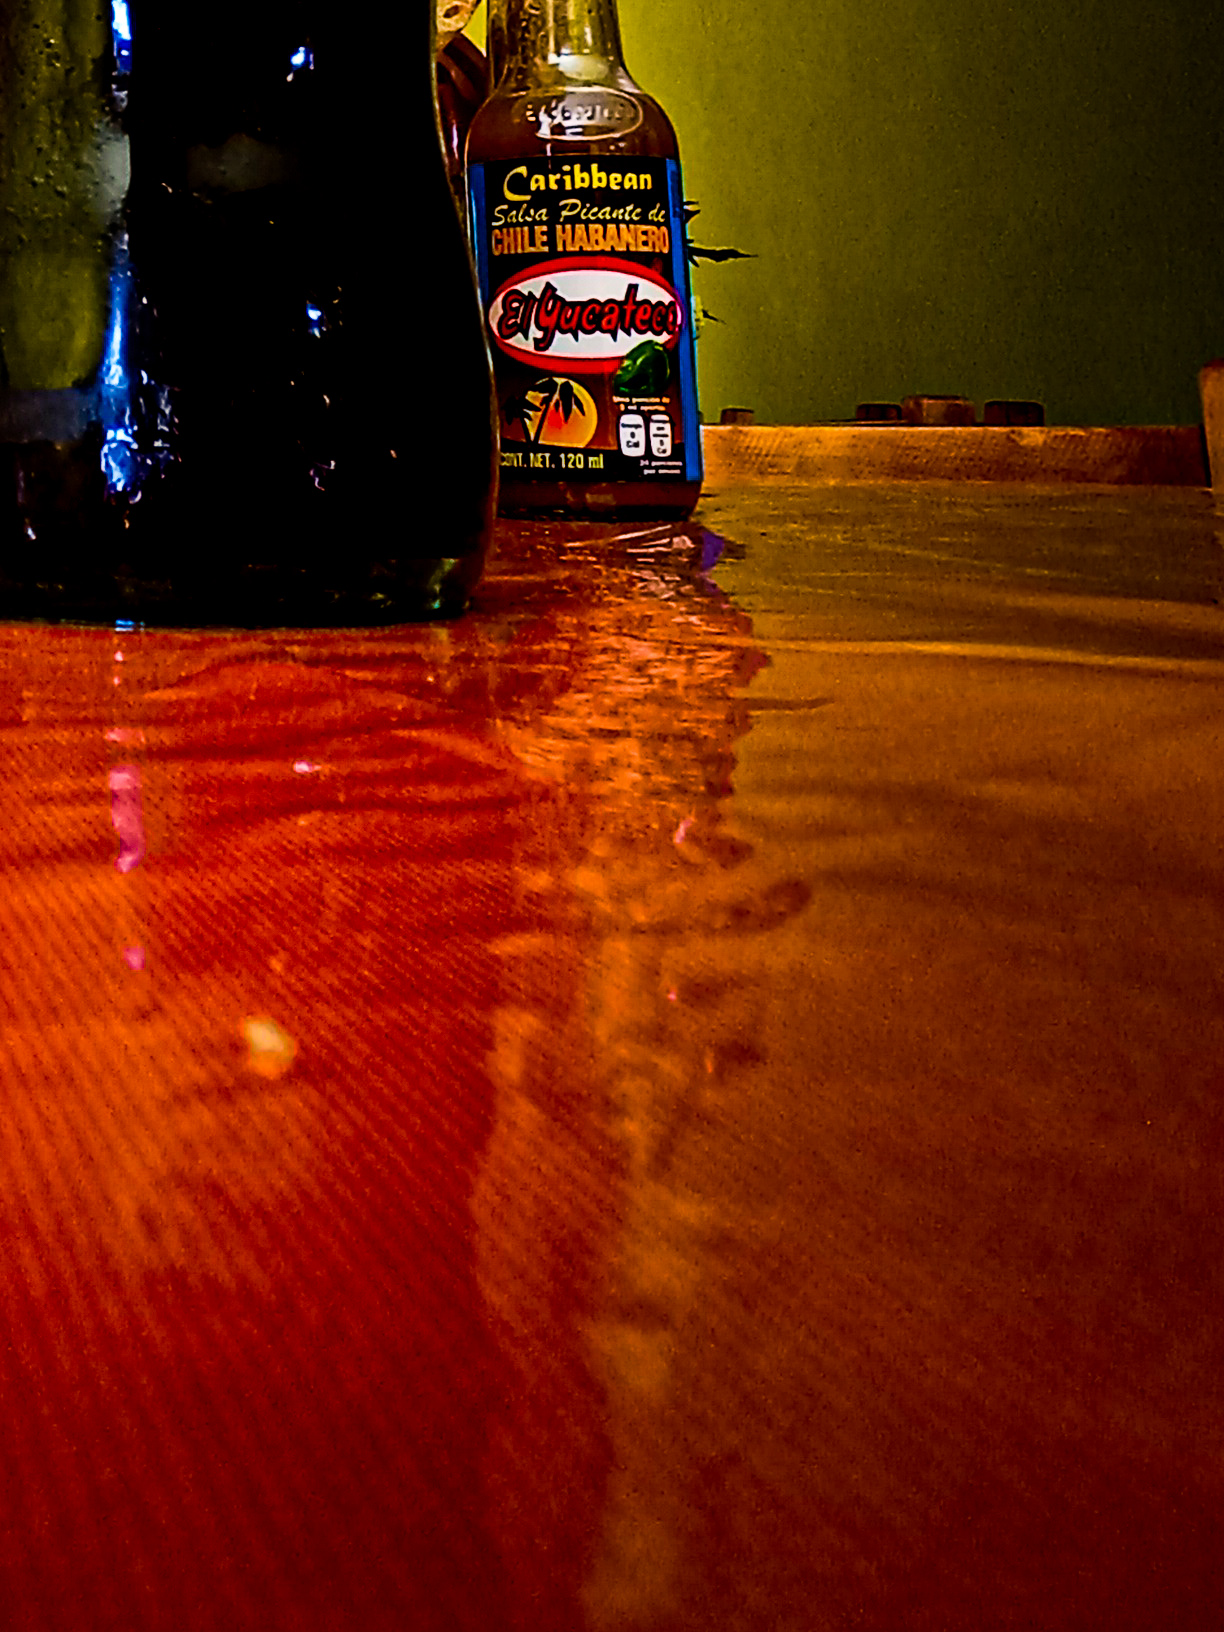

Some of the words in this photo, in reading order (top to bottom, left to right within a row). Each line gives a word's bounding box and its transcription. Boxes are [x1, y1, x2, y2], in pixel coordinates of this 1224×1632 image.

[503, 163, 653, 201] Caribbean
[491, 203, 549, 226] Salsa
[558, 198, 642, 222] Picante
[648, 202, 666, 222] de
[491, 225, 549, 256] CHILE
[555, 223, 669, 254] HABANERO
[559, 453, 584, 469] 120
[588, 453, 604, 469] ml
